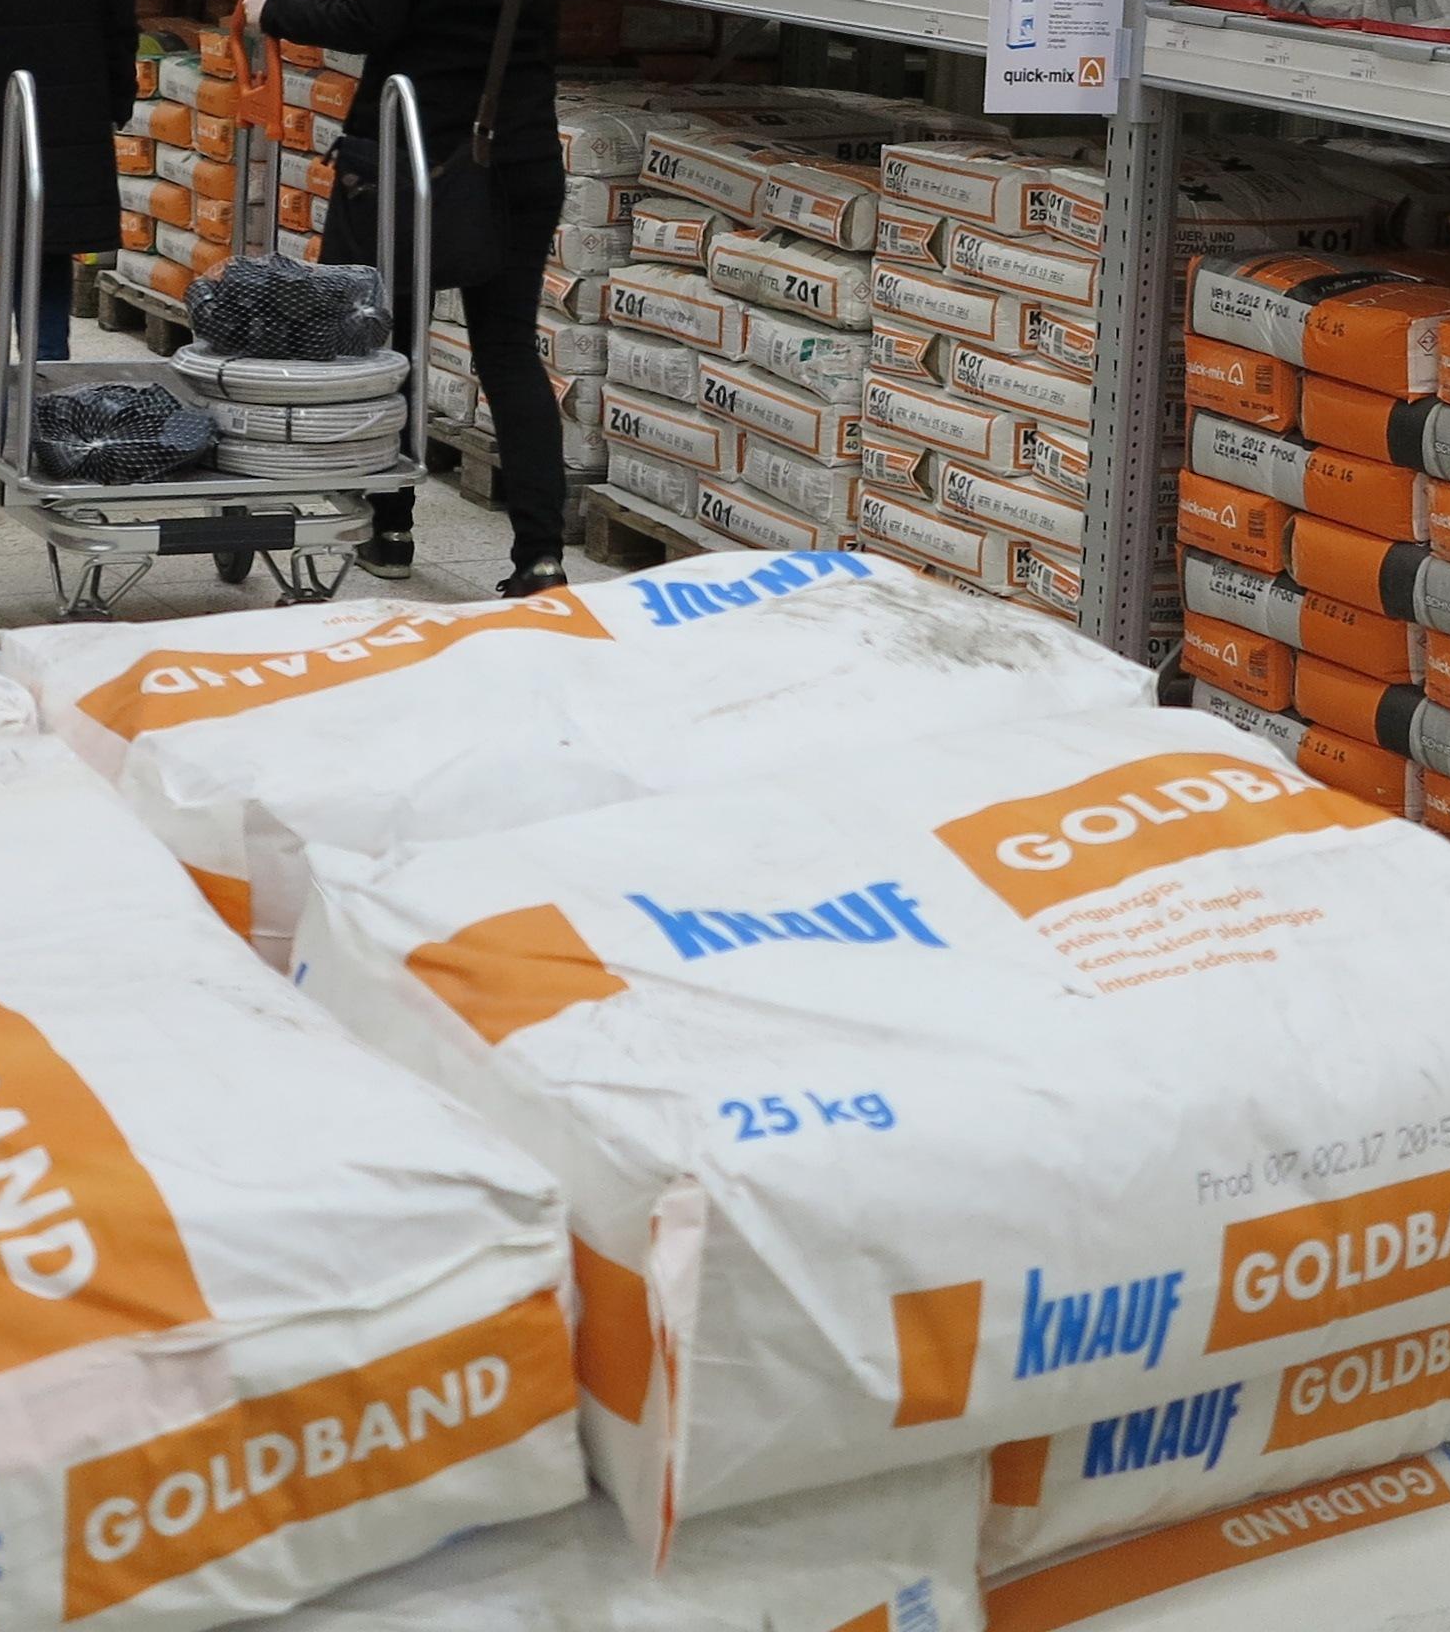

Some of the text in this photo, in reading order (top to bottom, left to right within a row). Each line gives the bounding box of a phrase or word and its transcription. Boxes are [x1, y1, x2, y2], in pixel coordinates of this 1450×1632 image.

[1003, 68, 1075, 85] quick-mix
[648, 150, 679, 179] Z01
[613, 288, 645, 317] Z01
[785, 275, 820, 307] Z01
[629, 550, 875, 627] KNAUF
[625, 878, 952, 962] KNAUF
[718, 1086, 896, 1145] 25 kg
[1197, 1168, 1254, 1206] Prod
[1013, 1266, 1187, 1382] KNAUF
[81, 1352, 515, 1566] GOLDBAND
[1081, 1380, 1245, 1481] KNAUF
[1221, 1465, 1436, 1548] GOLDBAND
